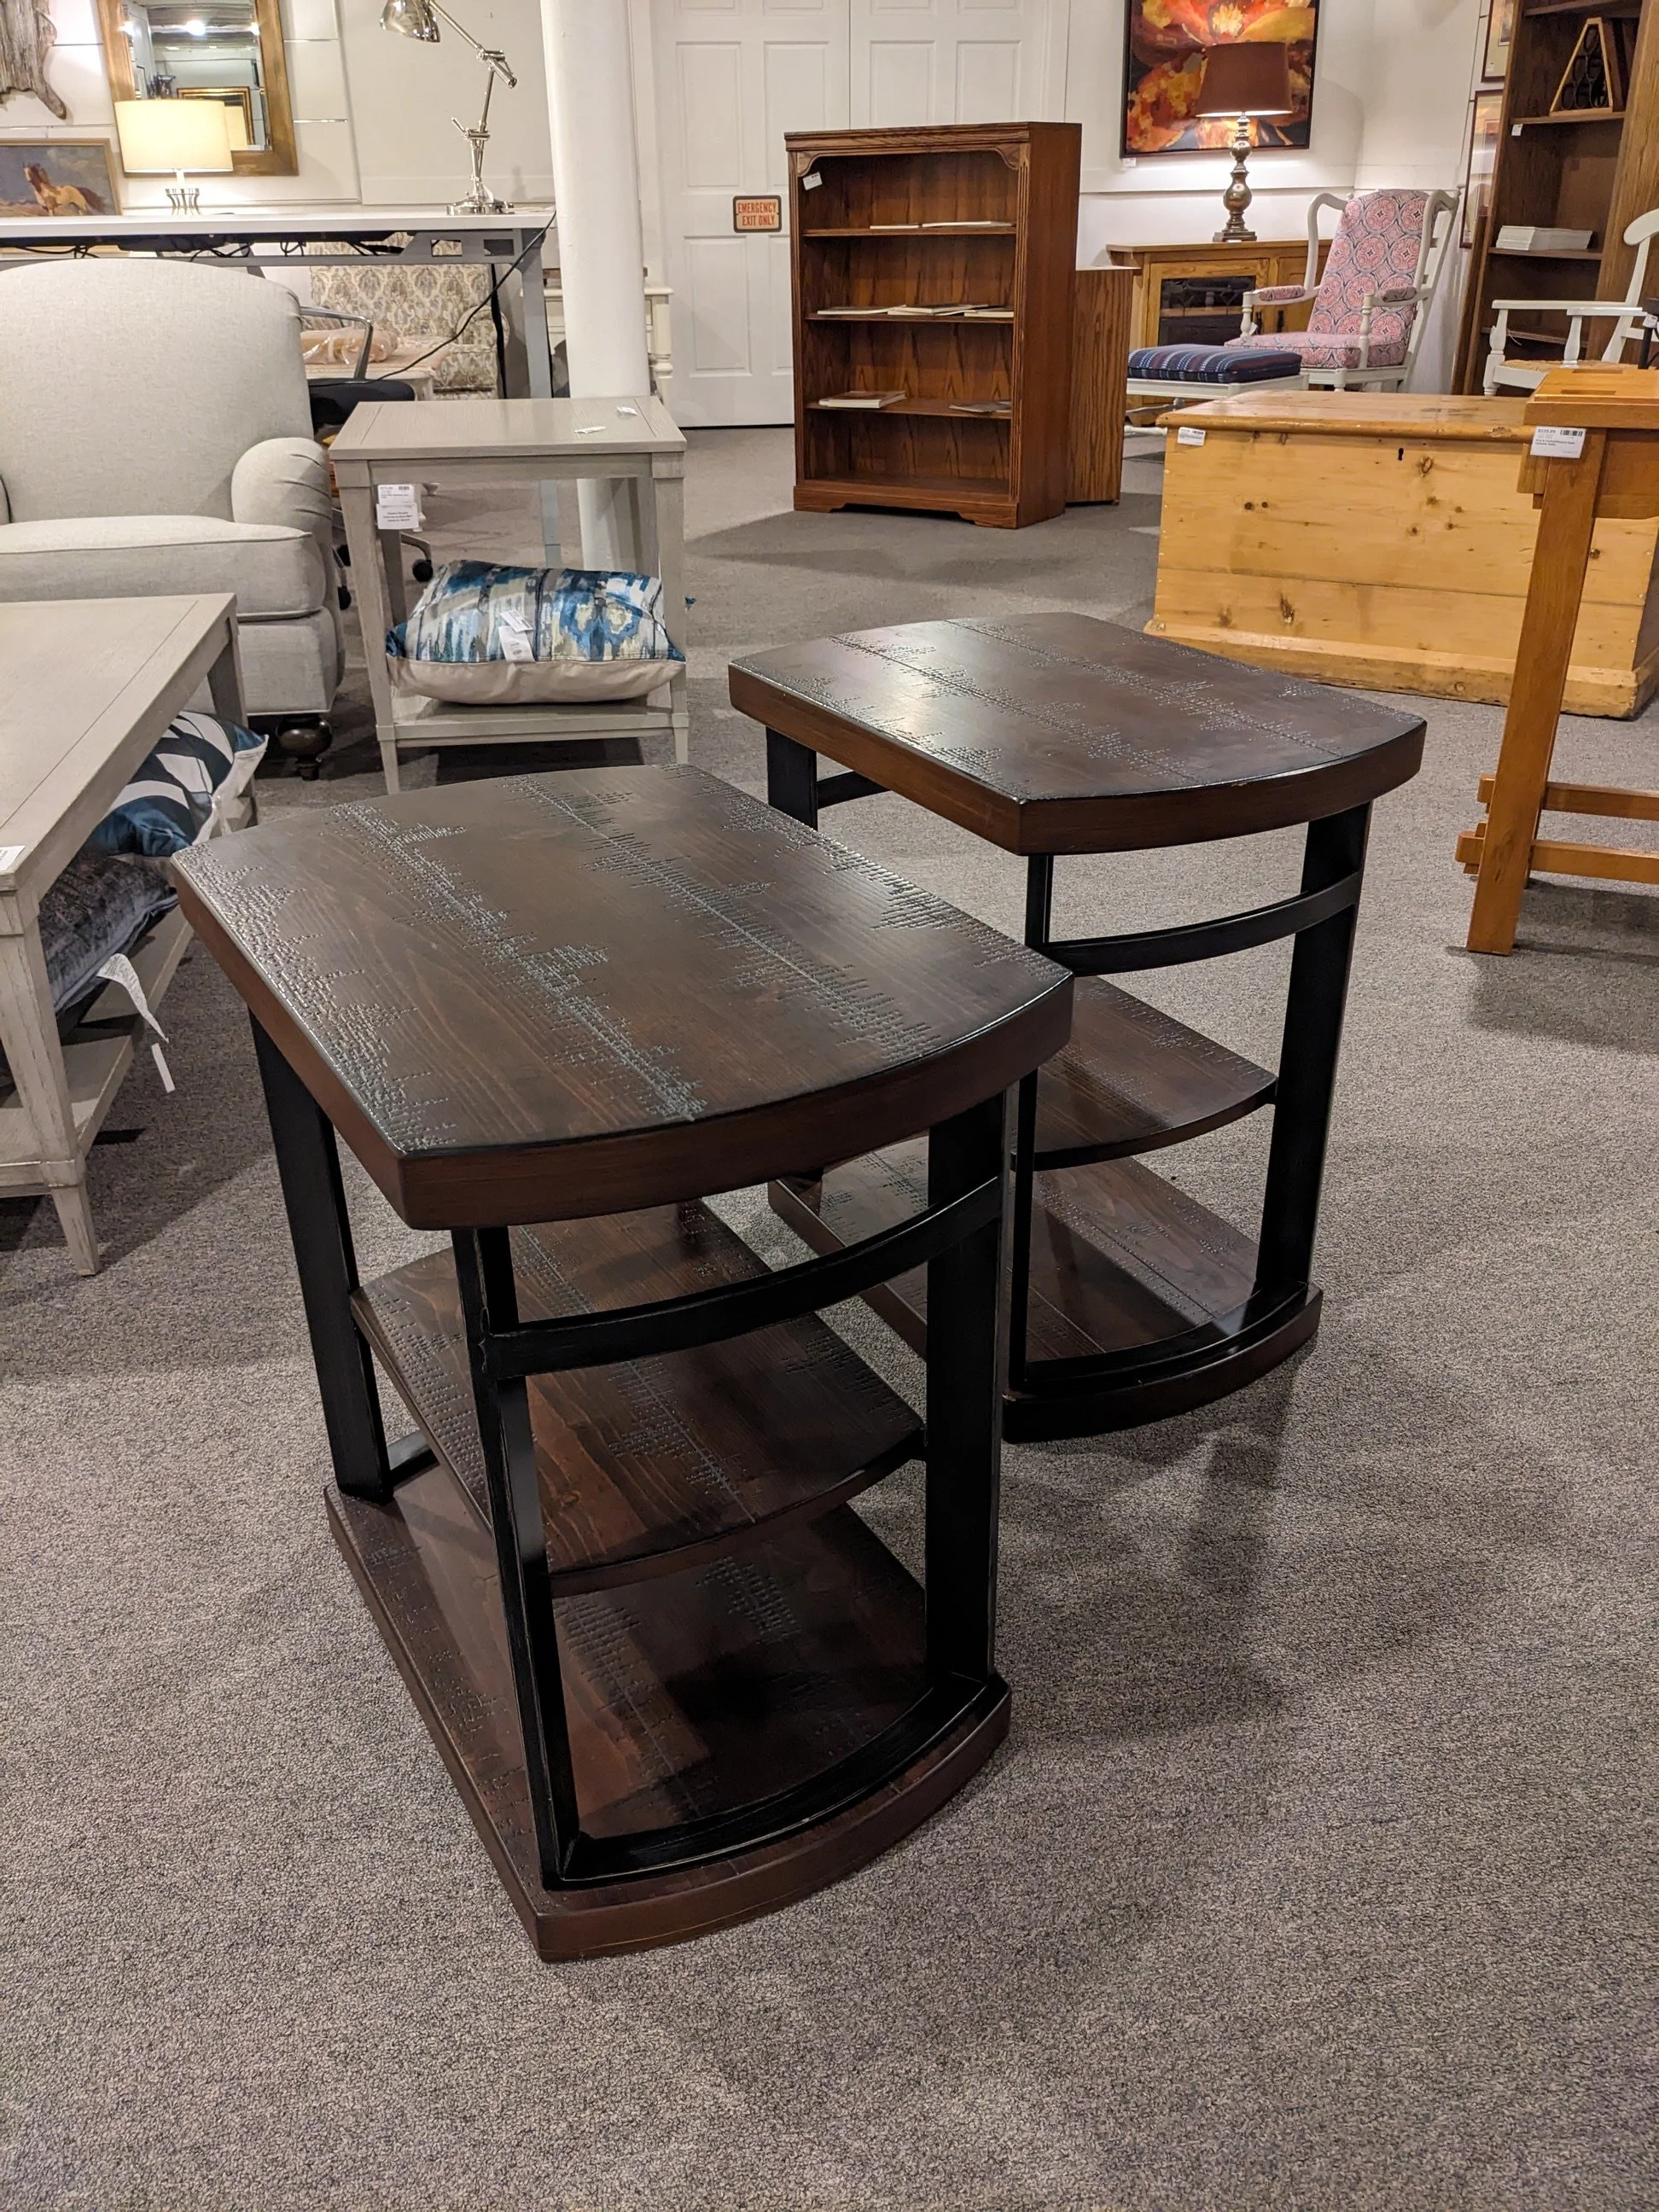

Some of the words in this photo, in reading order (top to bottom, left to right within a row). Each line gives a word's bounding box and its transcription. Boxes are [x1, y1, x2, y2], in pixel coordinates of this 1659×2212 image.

[737, 201, 777, 213] EMERGENCY
[742, 215, 756, 226] EXIT
[759, 214, 775, 225] ONLY
